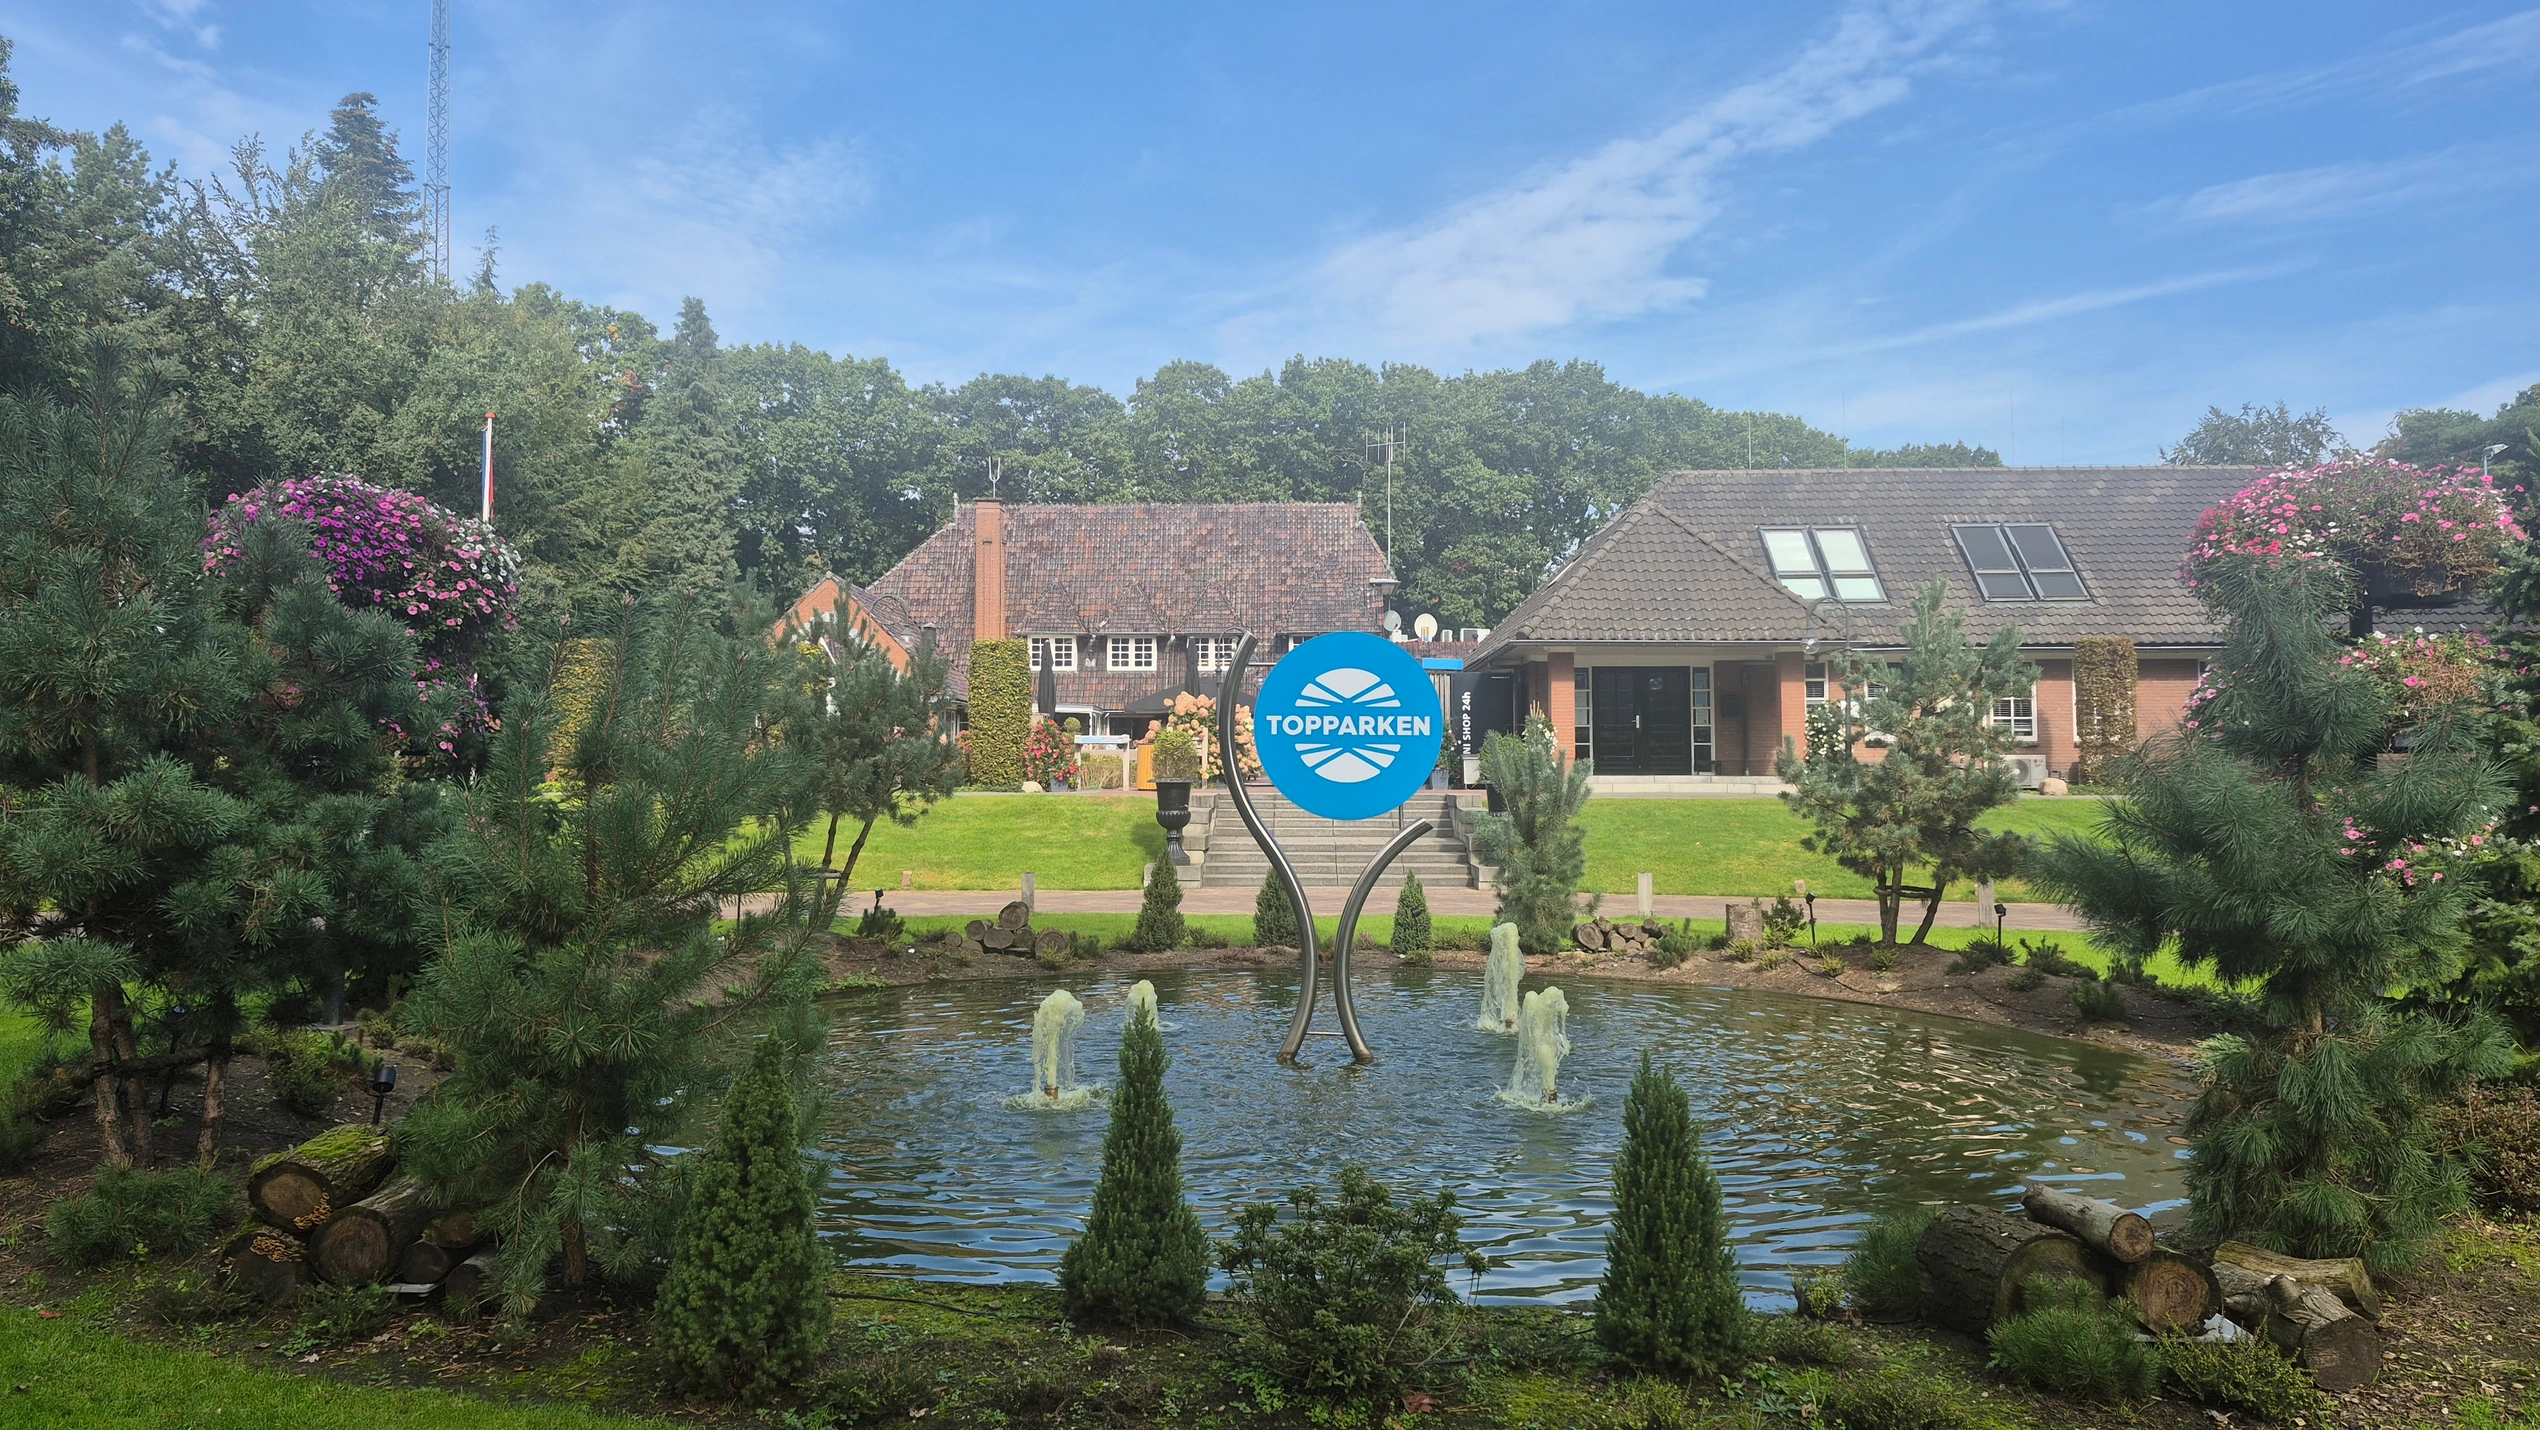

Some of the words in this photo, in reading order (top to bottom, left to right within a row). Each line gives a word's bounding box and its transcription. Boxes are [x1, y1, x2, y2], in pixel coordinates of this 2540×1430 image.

[1461, 691, 1471, 711] 24h
[1266, 715, 1431, 736] TOPPARKEN
[1462, 713, 1471, 741] SHOP
[1462, 743, 1471, 755] NI
